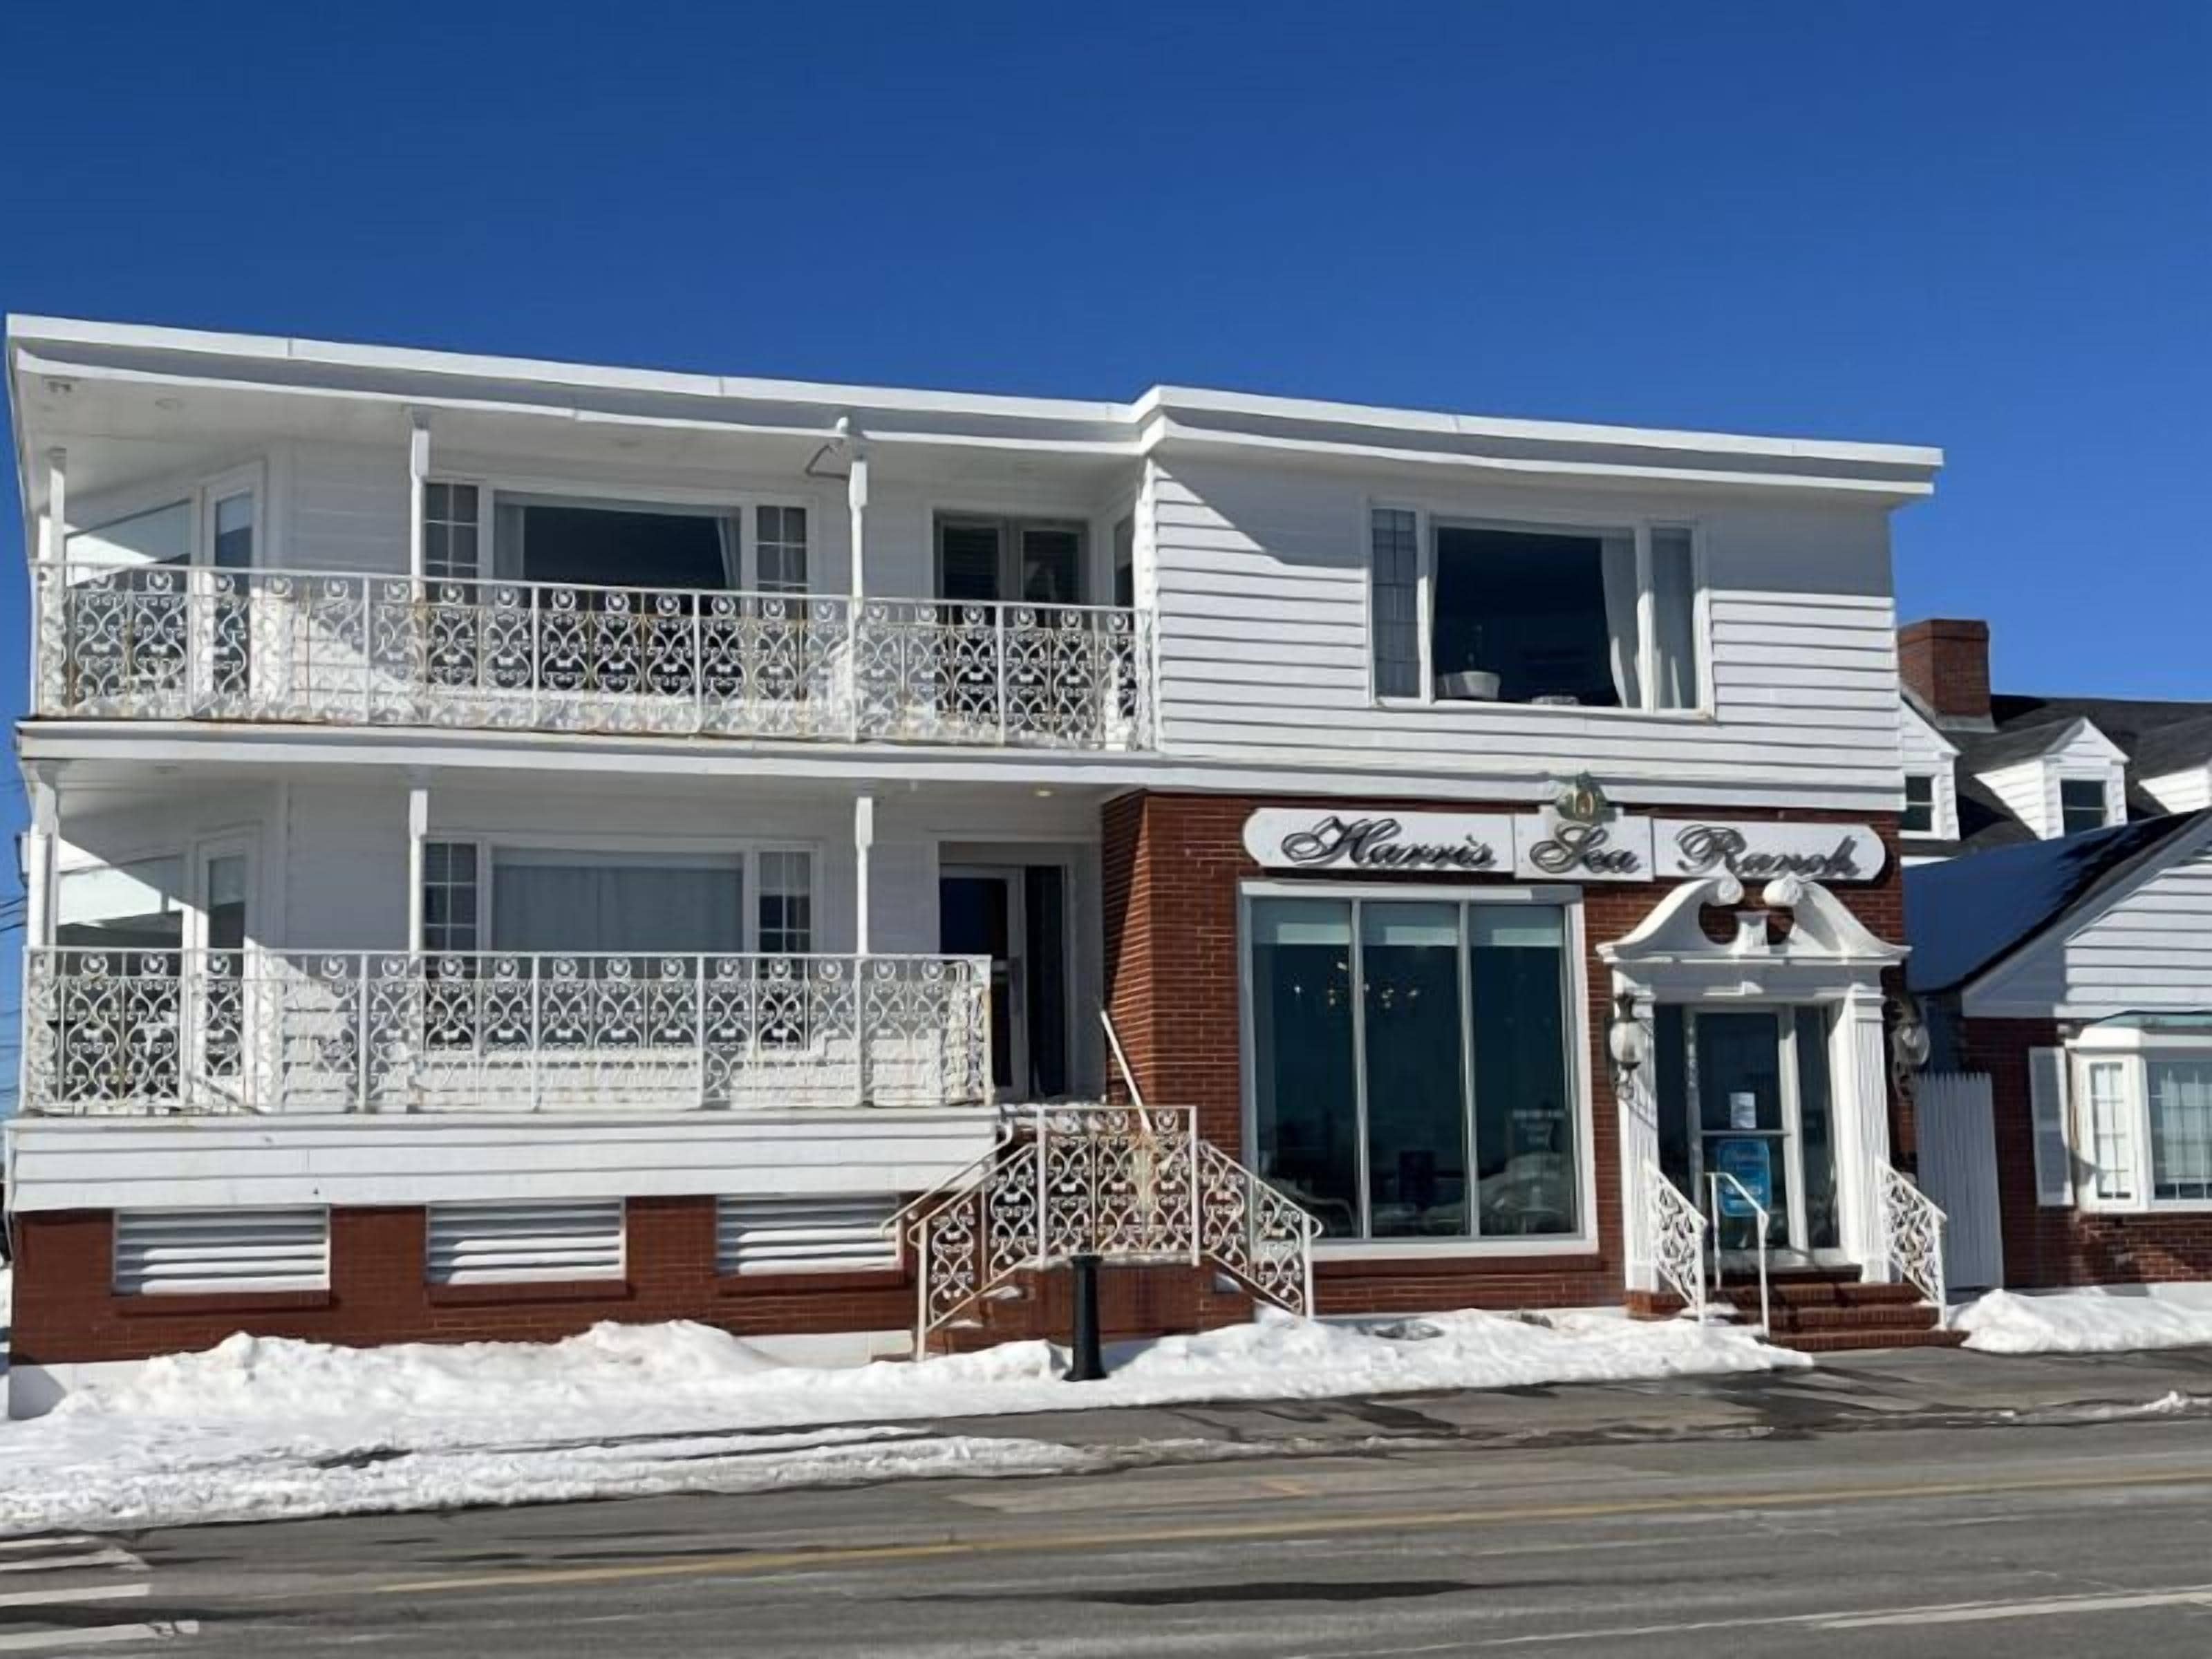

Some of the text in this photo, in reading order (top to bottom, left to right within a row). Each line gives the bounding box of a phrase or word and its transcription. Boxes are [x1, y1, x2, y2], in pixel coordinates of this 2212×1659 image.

[1281, 816, 1861, 878] Harris Sea Ranch
